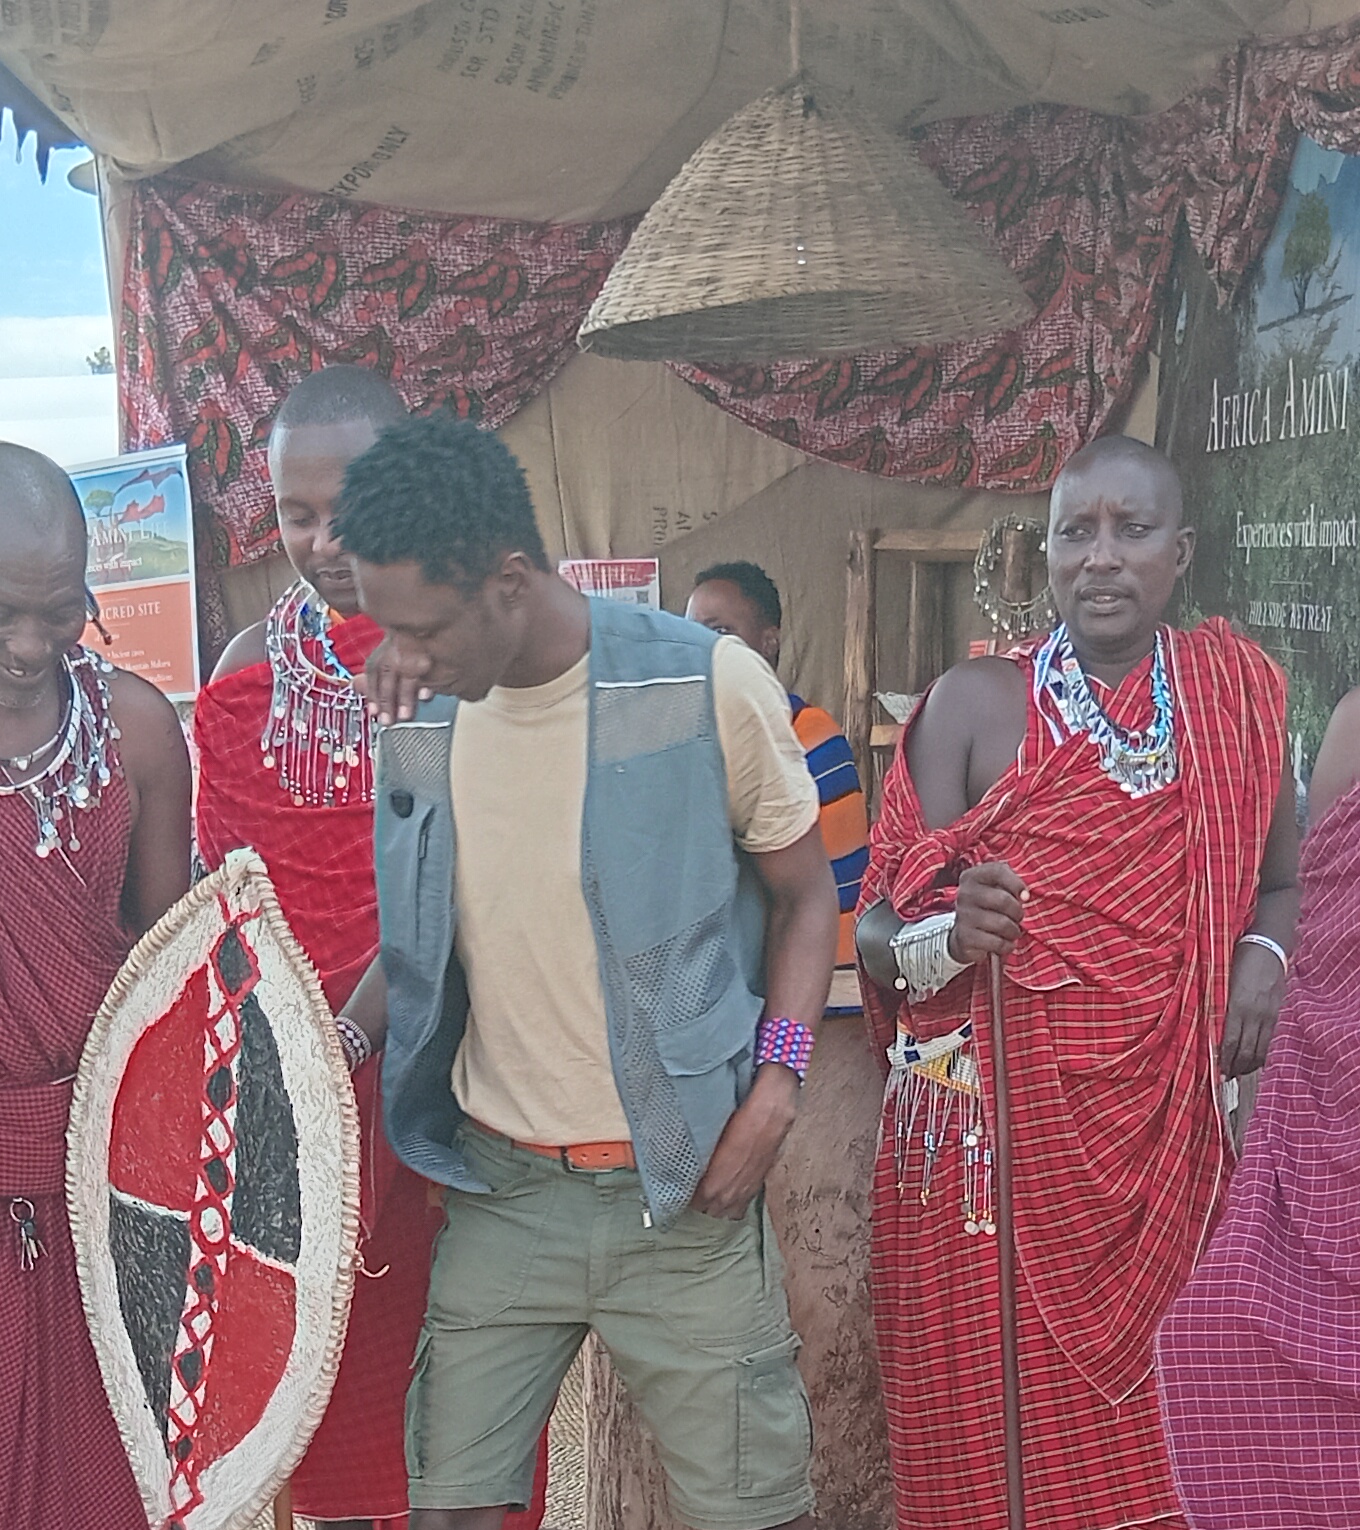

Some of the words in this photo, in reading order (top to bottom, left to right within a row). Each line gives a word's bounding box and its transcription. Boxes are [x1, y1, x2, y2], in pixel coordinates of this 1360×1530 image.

[1205, 378, 1271, 452] AFRICA
[1279, 358, 1349, 440] AMINI
[1236, 510, 1292, 565] Experiences
[1293, 503, 1316, 547] with
[1318, 508, 1357, 566] impact
[99, 604, 134, 621] ACRED
[138, 601, 161, 618] SITE
[1248, 601, 1287, 628] HILLSIDE
[1289, 603, 1332, 633] RETREAT
